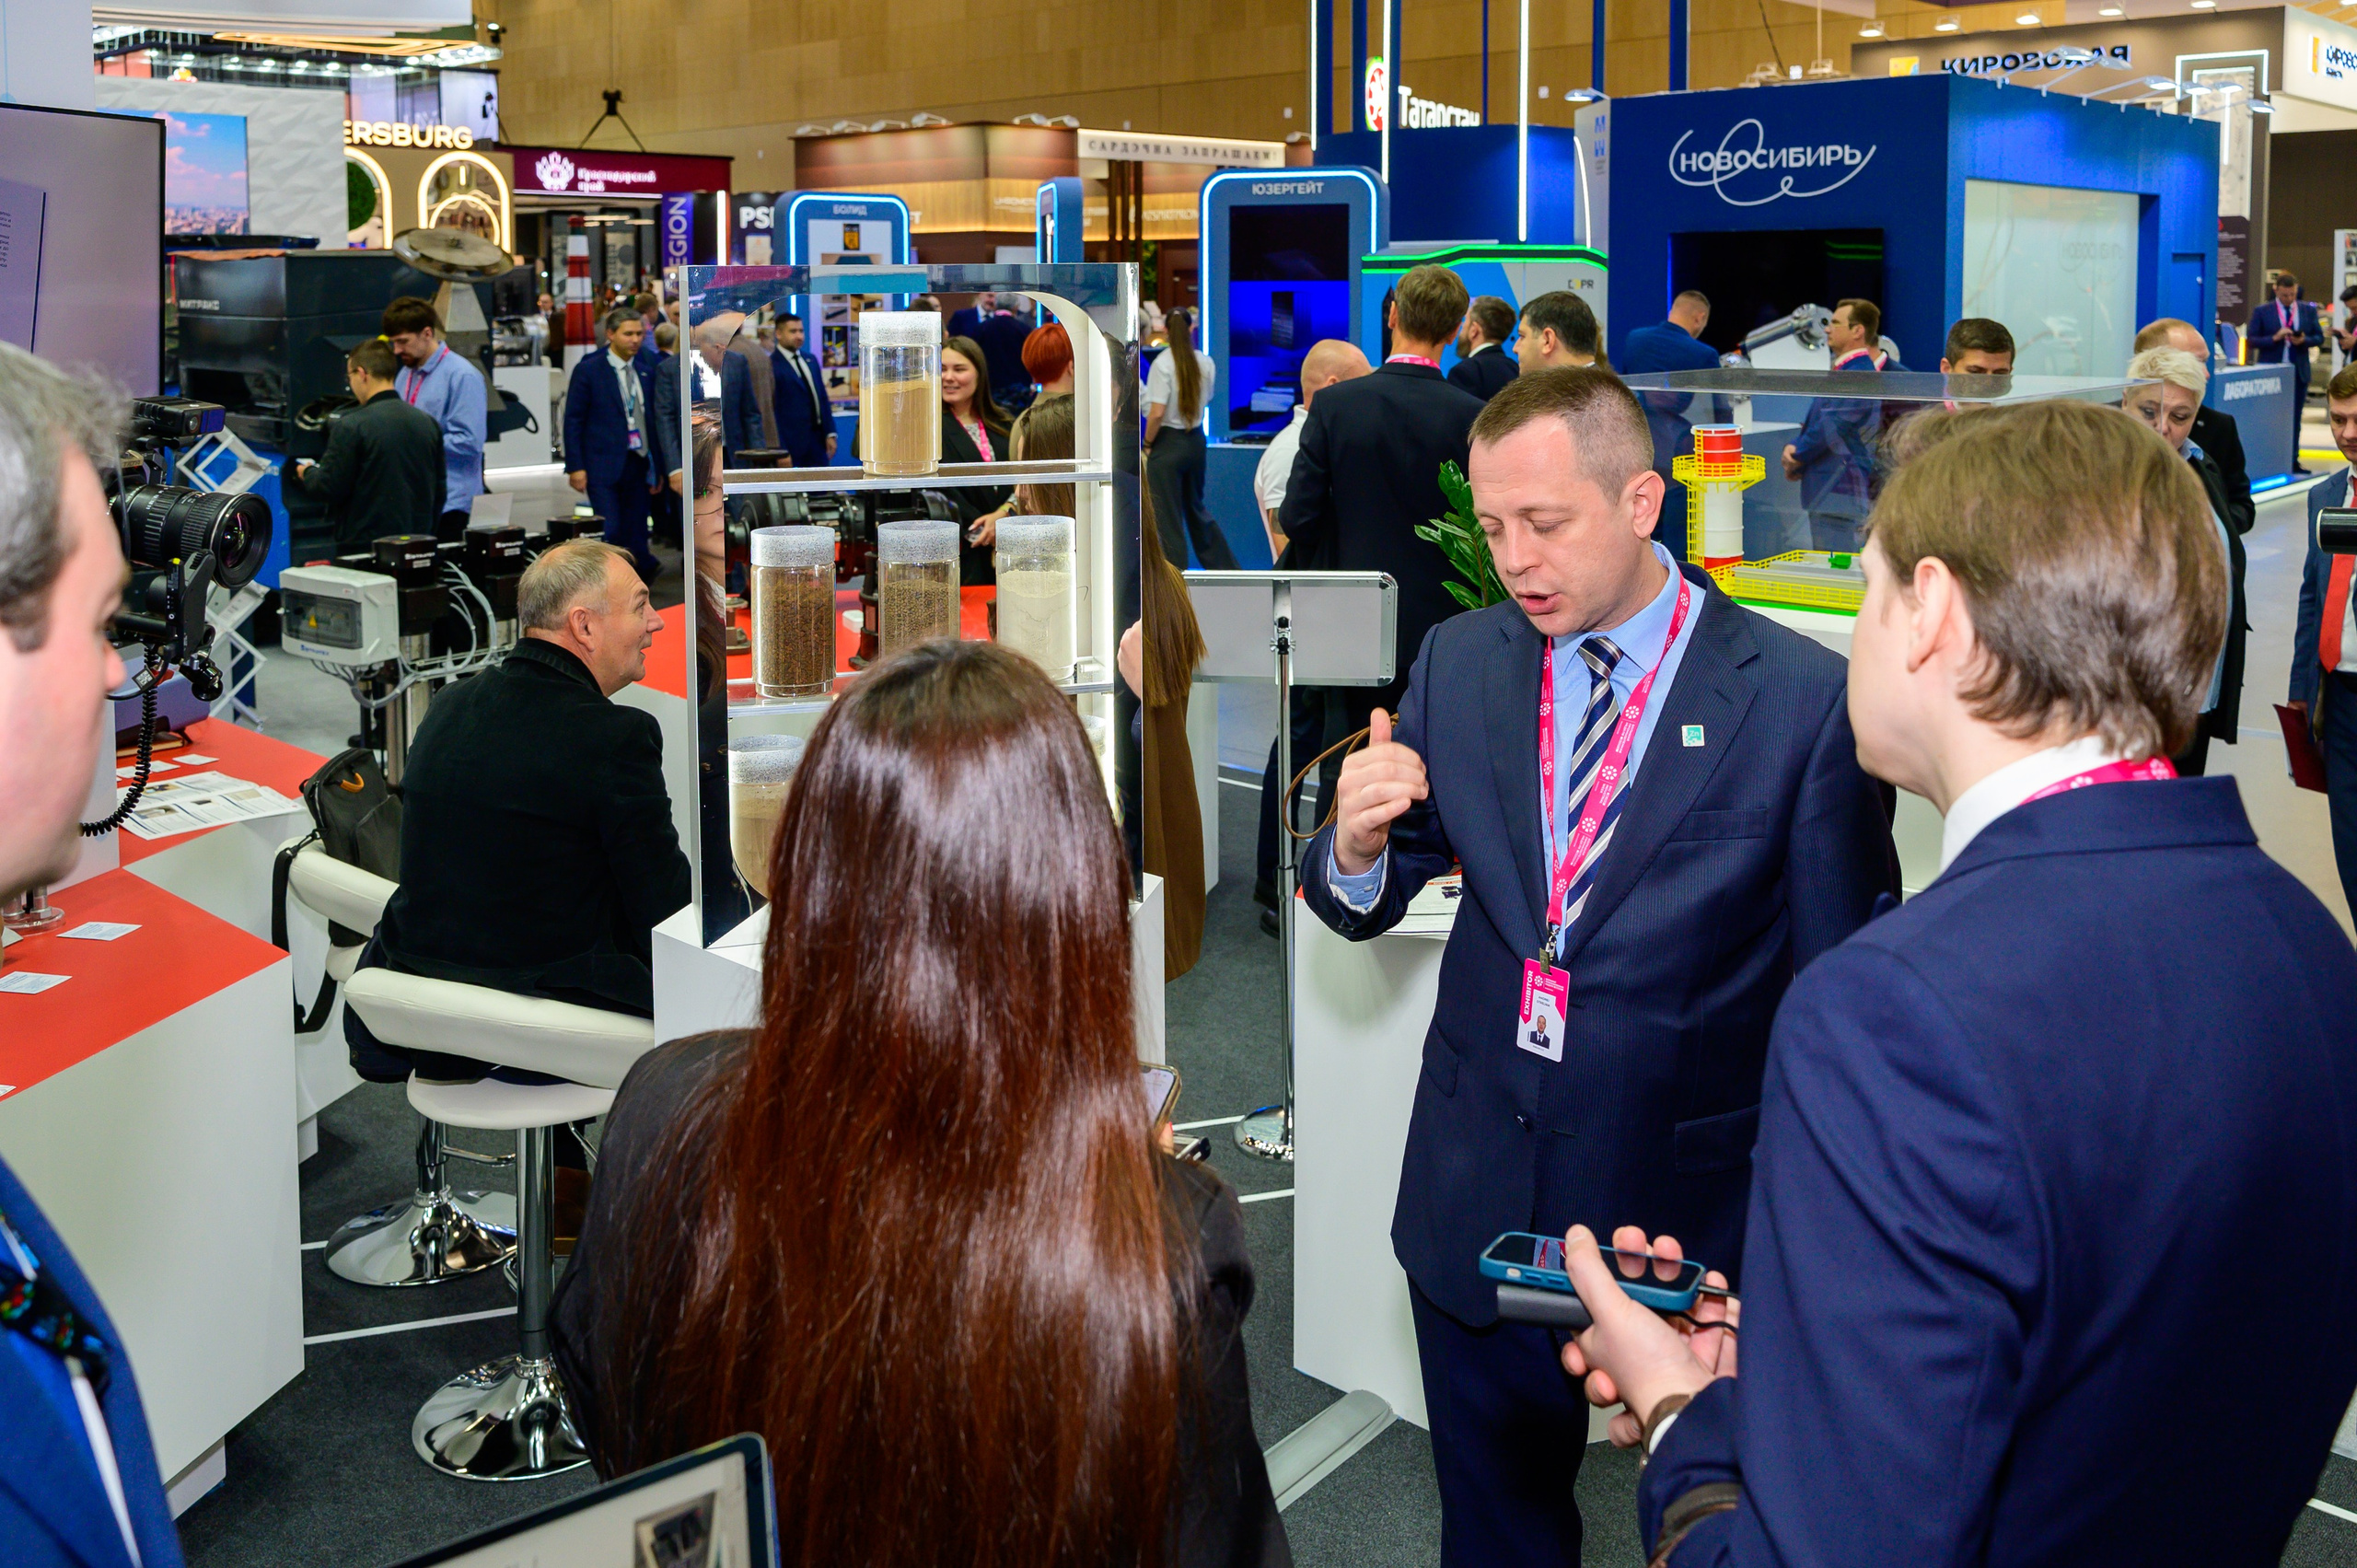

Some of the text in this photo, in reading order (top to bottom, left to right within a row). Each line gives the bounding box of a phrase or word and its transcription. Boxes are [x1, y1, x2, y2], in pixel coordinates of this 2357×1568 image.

[1088, 139, 1172, 156] САРДЭЧНА
[1680, 145, 1863, 172] НОВОСИБИРЬ
[1252, 180, 1324, 195] ЮЗЕРГЕЙТ
[1524, 970, 1533, 1015] EXHIBITOR
